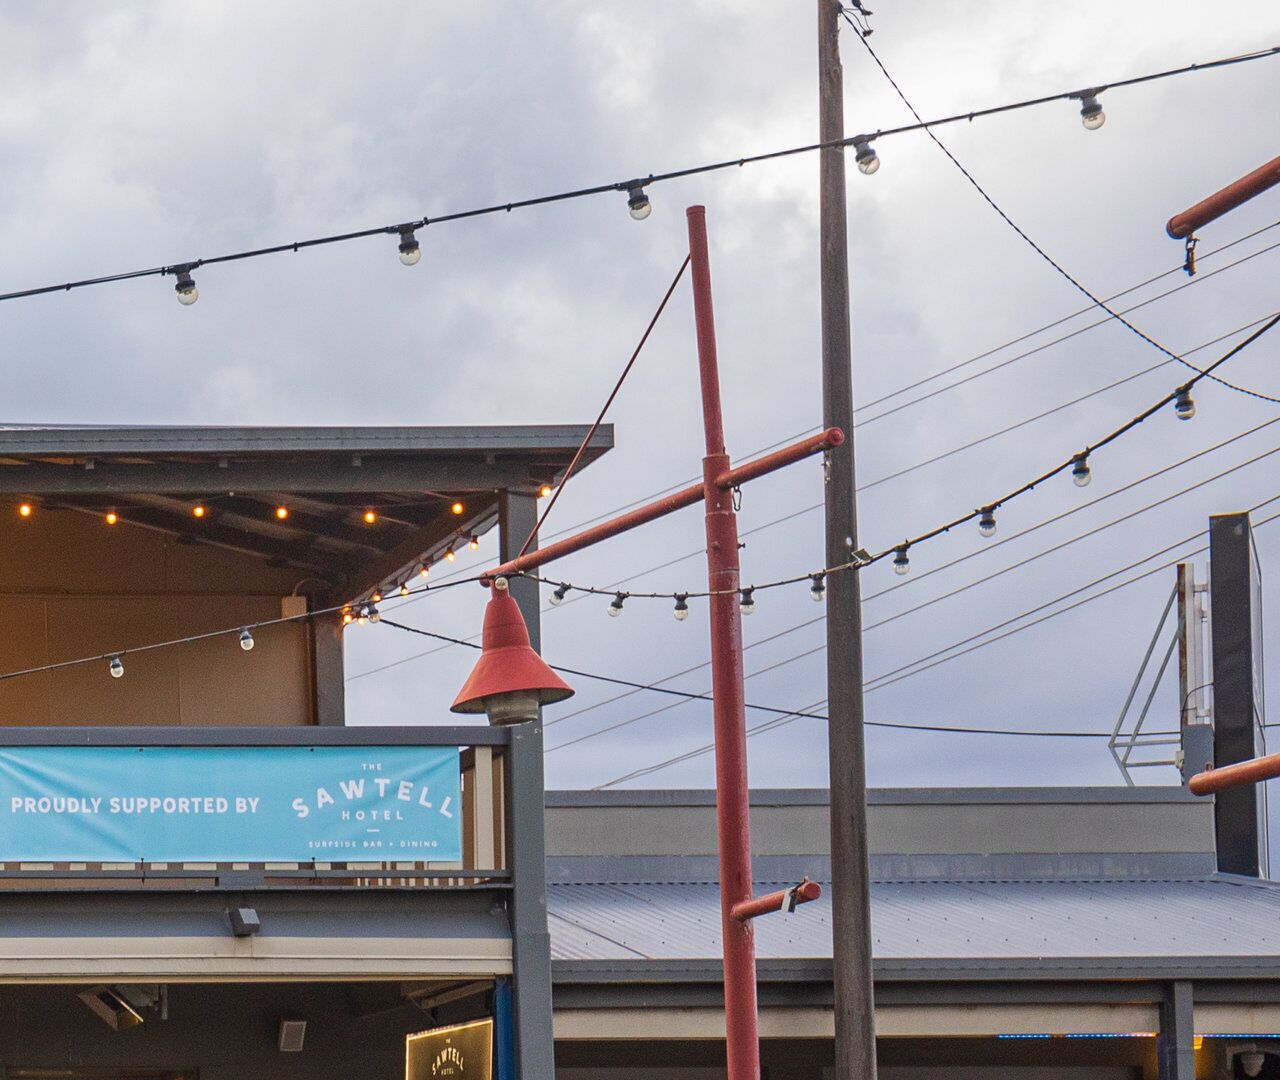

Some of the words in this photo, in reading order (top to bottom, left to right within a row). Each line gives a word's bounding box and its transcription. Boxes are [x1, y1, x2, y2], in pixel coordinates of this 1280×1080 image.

[362, 763, 382, 771] THE
[292, 777, 454, 818] SAWTELL
[11, 797, 102, 814] PROUDLY
[110, 797, 228, 814] SUPPORTED
[235, 797, 259, 814] BY
[342, 810, 403, 820] HOTEL
[400, 840, 438, 848] DINING
[432, 1047, 464, 1076] SAWTELL
